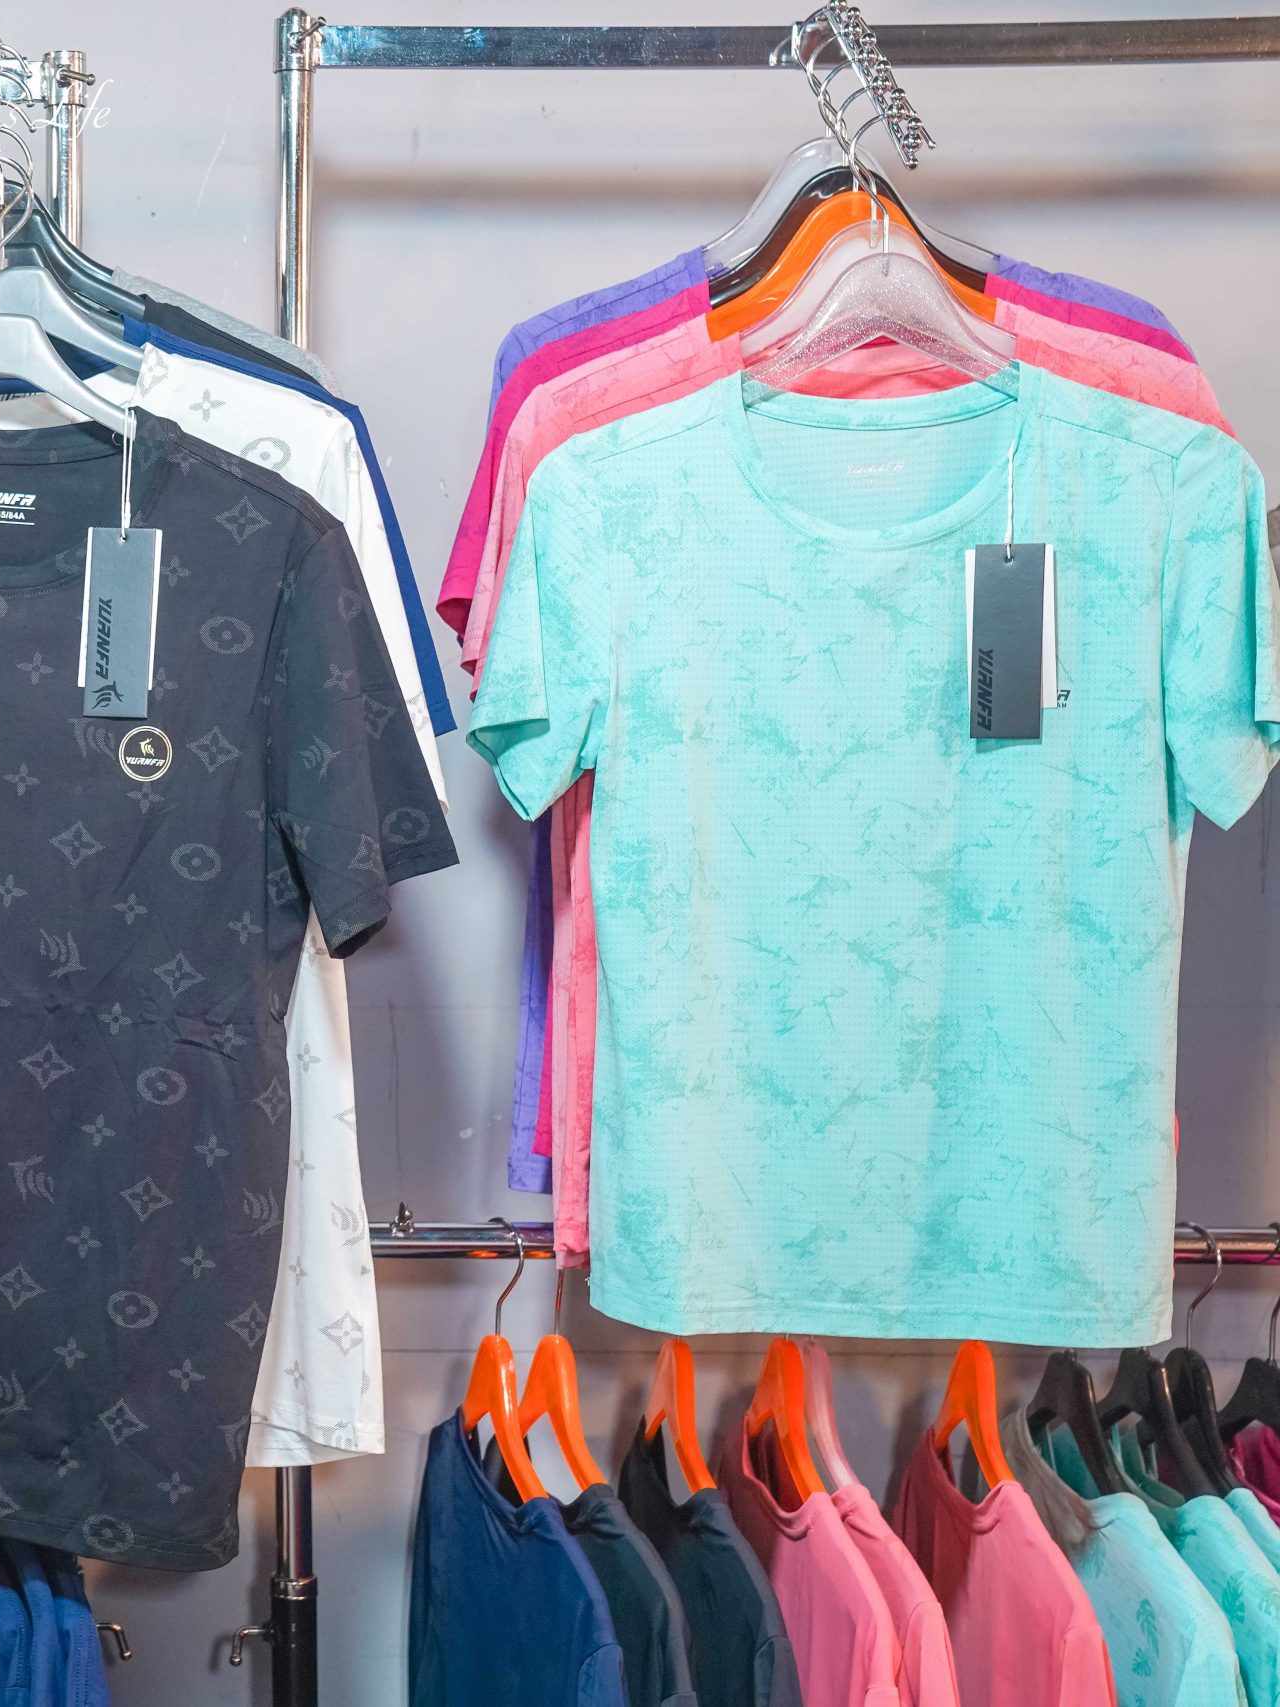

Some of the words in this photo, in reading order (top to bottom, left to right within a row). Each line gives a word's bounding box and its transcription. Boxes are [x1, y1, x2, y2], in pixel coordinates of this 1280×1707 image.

[95, 597, 113, 680] YUANFA
[977, 648, 994, 732] YUANFA
[125, 756, 166, 767] YUANFA
